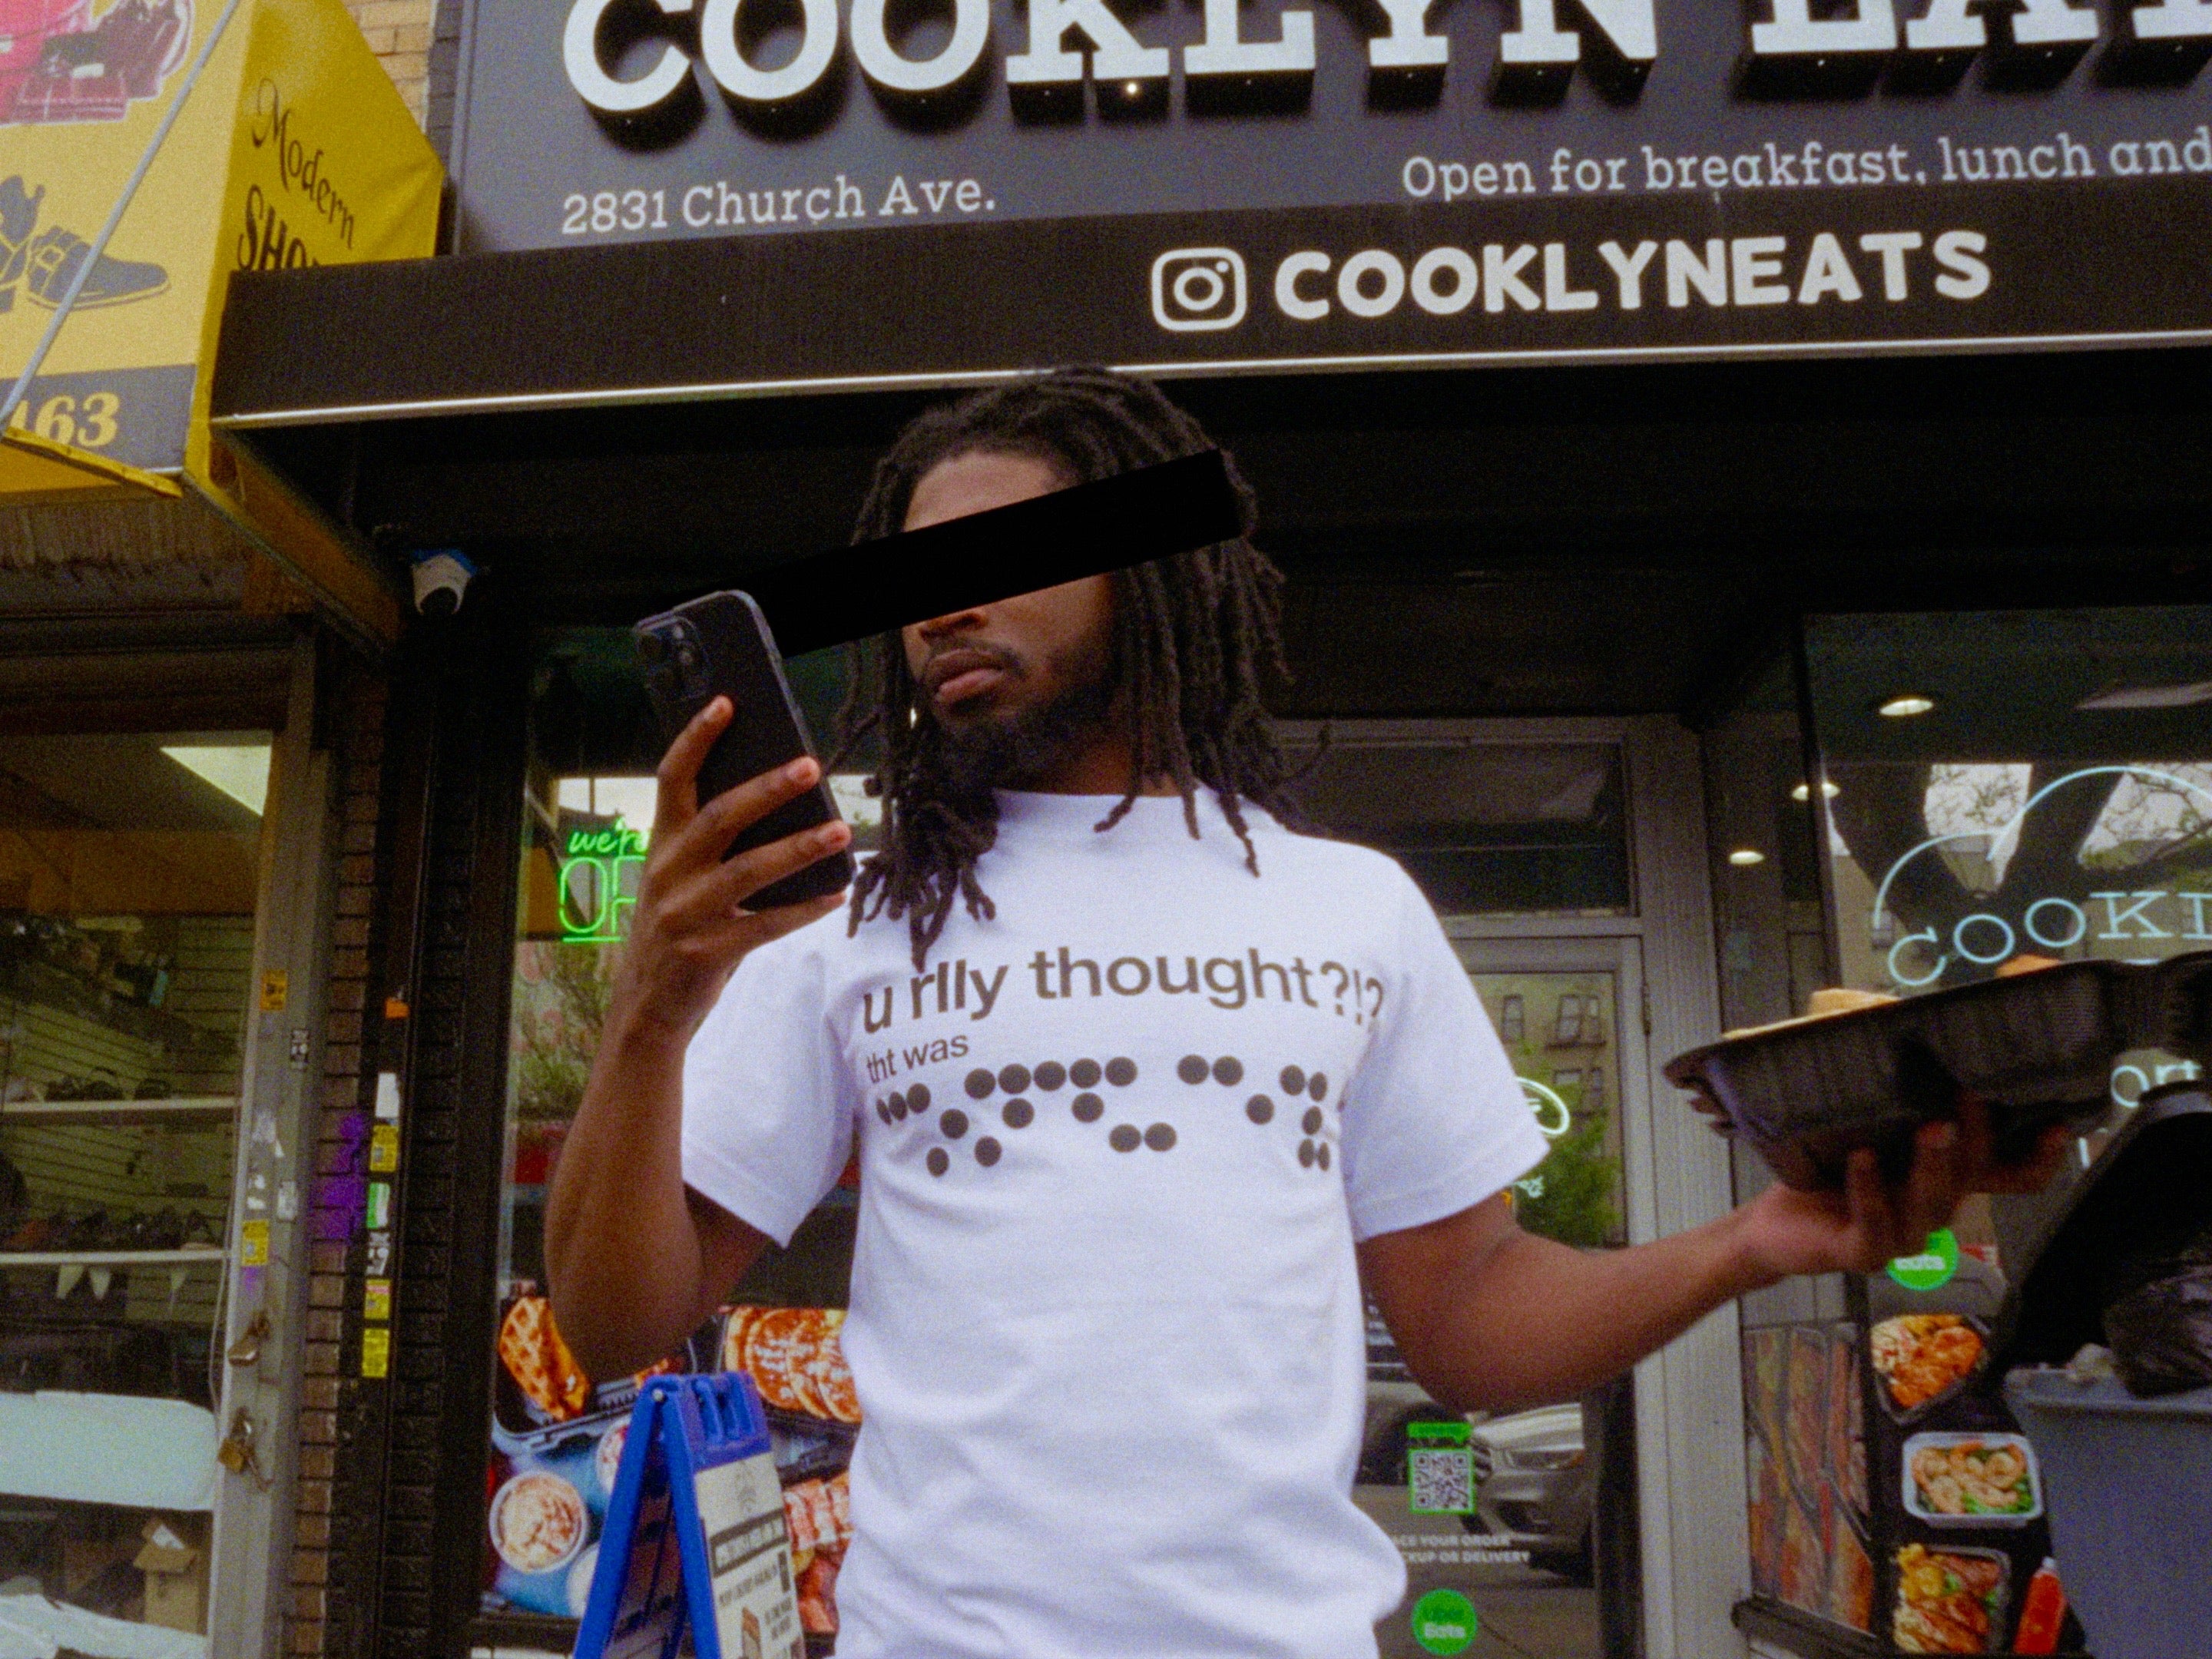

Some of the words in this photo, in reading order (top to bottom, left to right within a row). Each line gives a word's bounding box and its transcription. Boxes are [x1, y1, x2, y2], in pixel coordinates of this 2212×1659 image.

[251, 77, 355, 250] Modern
[1403, 156, 1535, 201] Open
[1549, 149, 1625, 194] for
[1938, 132, 2096, 181] lunch
[2108, 125, 2212, 174] and
[561, 190, 667, 235] 2831
[682, 175, 866, 227] Church
[879, 176, 996, 217] Ave.
[1274, 230, 1992, 320] COOKLYNEATS
[863, 986, 893, 1034] u
[911, 959, 1009, 1021] rlly
[1028, 946, 1383, 1025] thought?!?
[866, 1049, 897, 1084] tht
[902, 1034, 970, 1071] was
